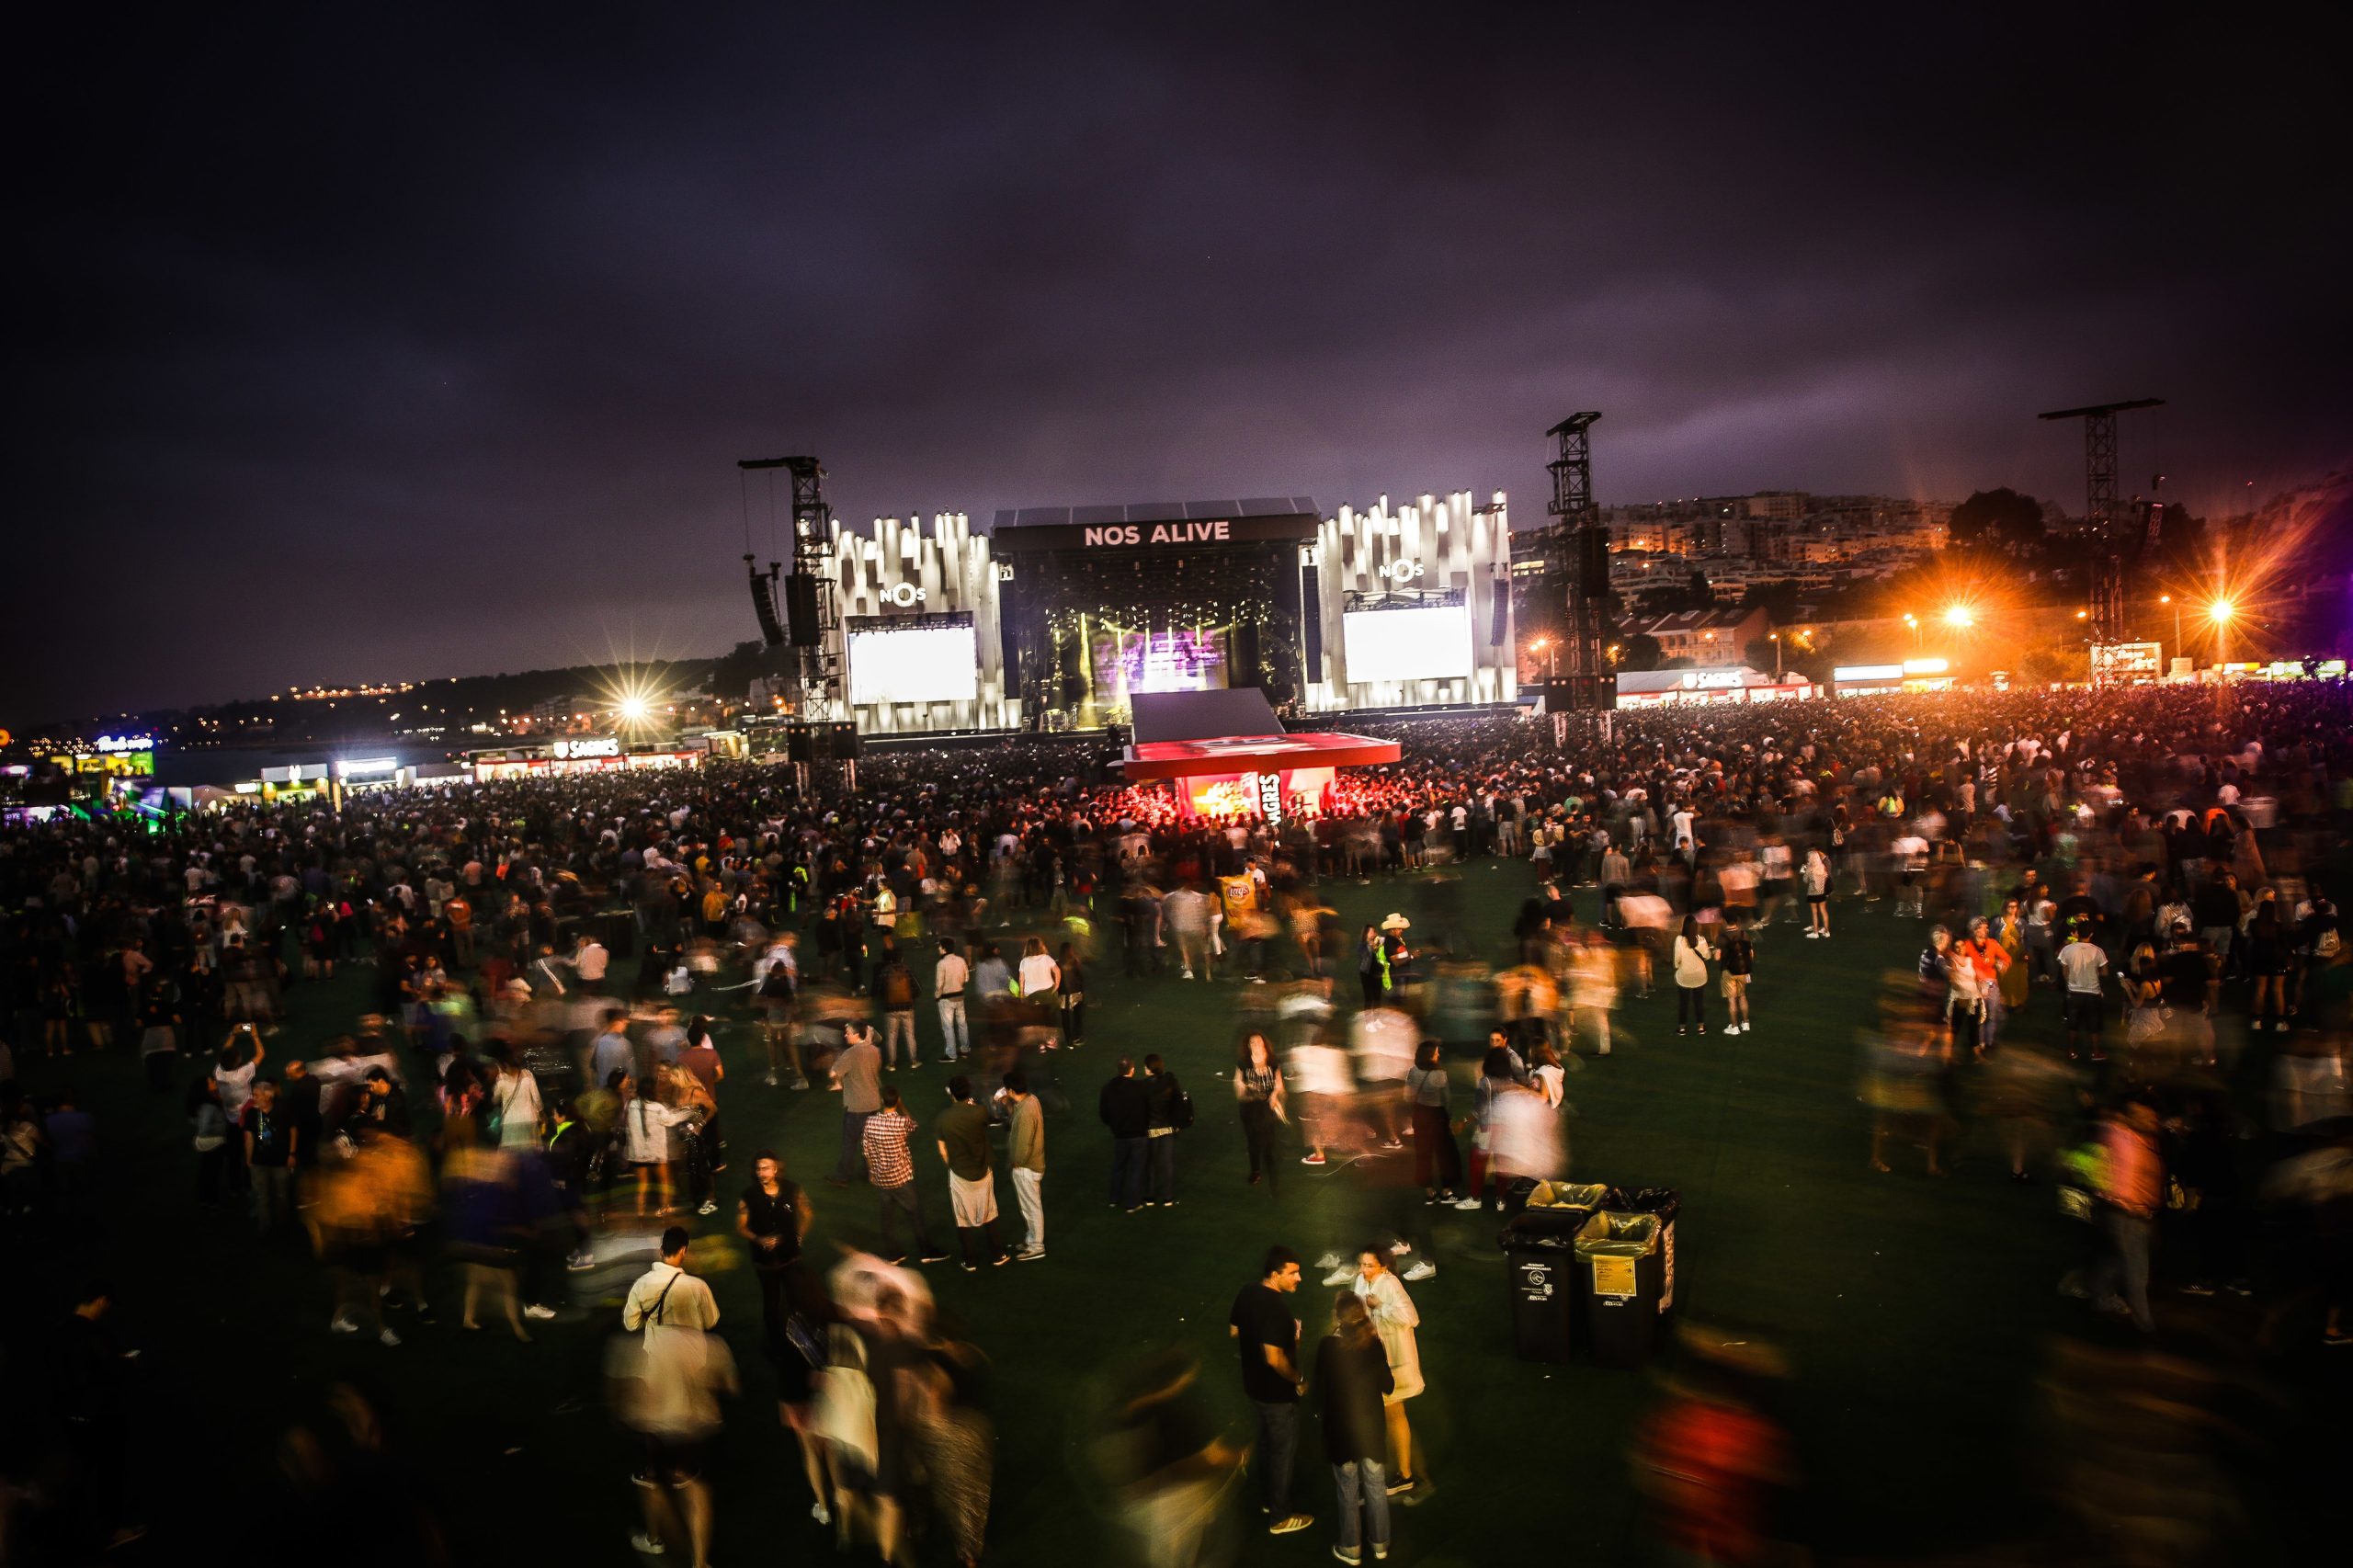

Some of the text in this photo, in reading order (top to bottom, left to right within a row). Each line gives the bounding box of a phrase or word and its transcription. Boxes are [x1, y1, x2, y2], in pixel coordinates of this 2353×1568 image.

[1086, 521, 1230, 546] NOS ALIVE
[1379, 558, 1424, 583] NOS
[880, 582, 926, 608] NOS
